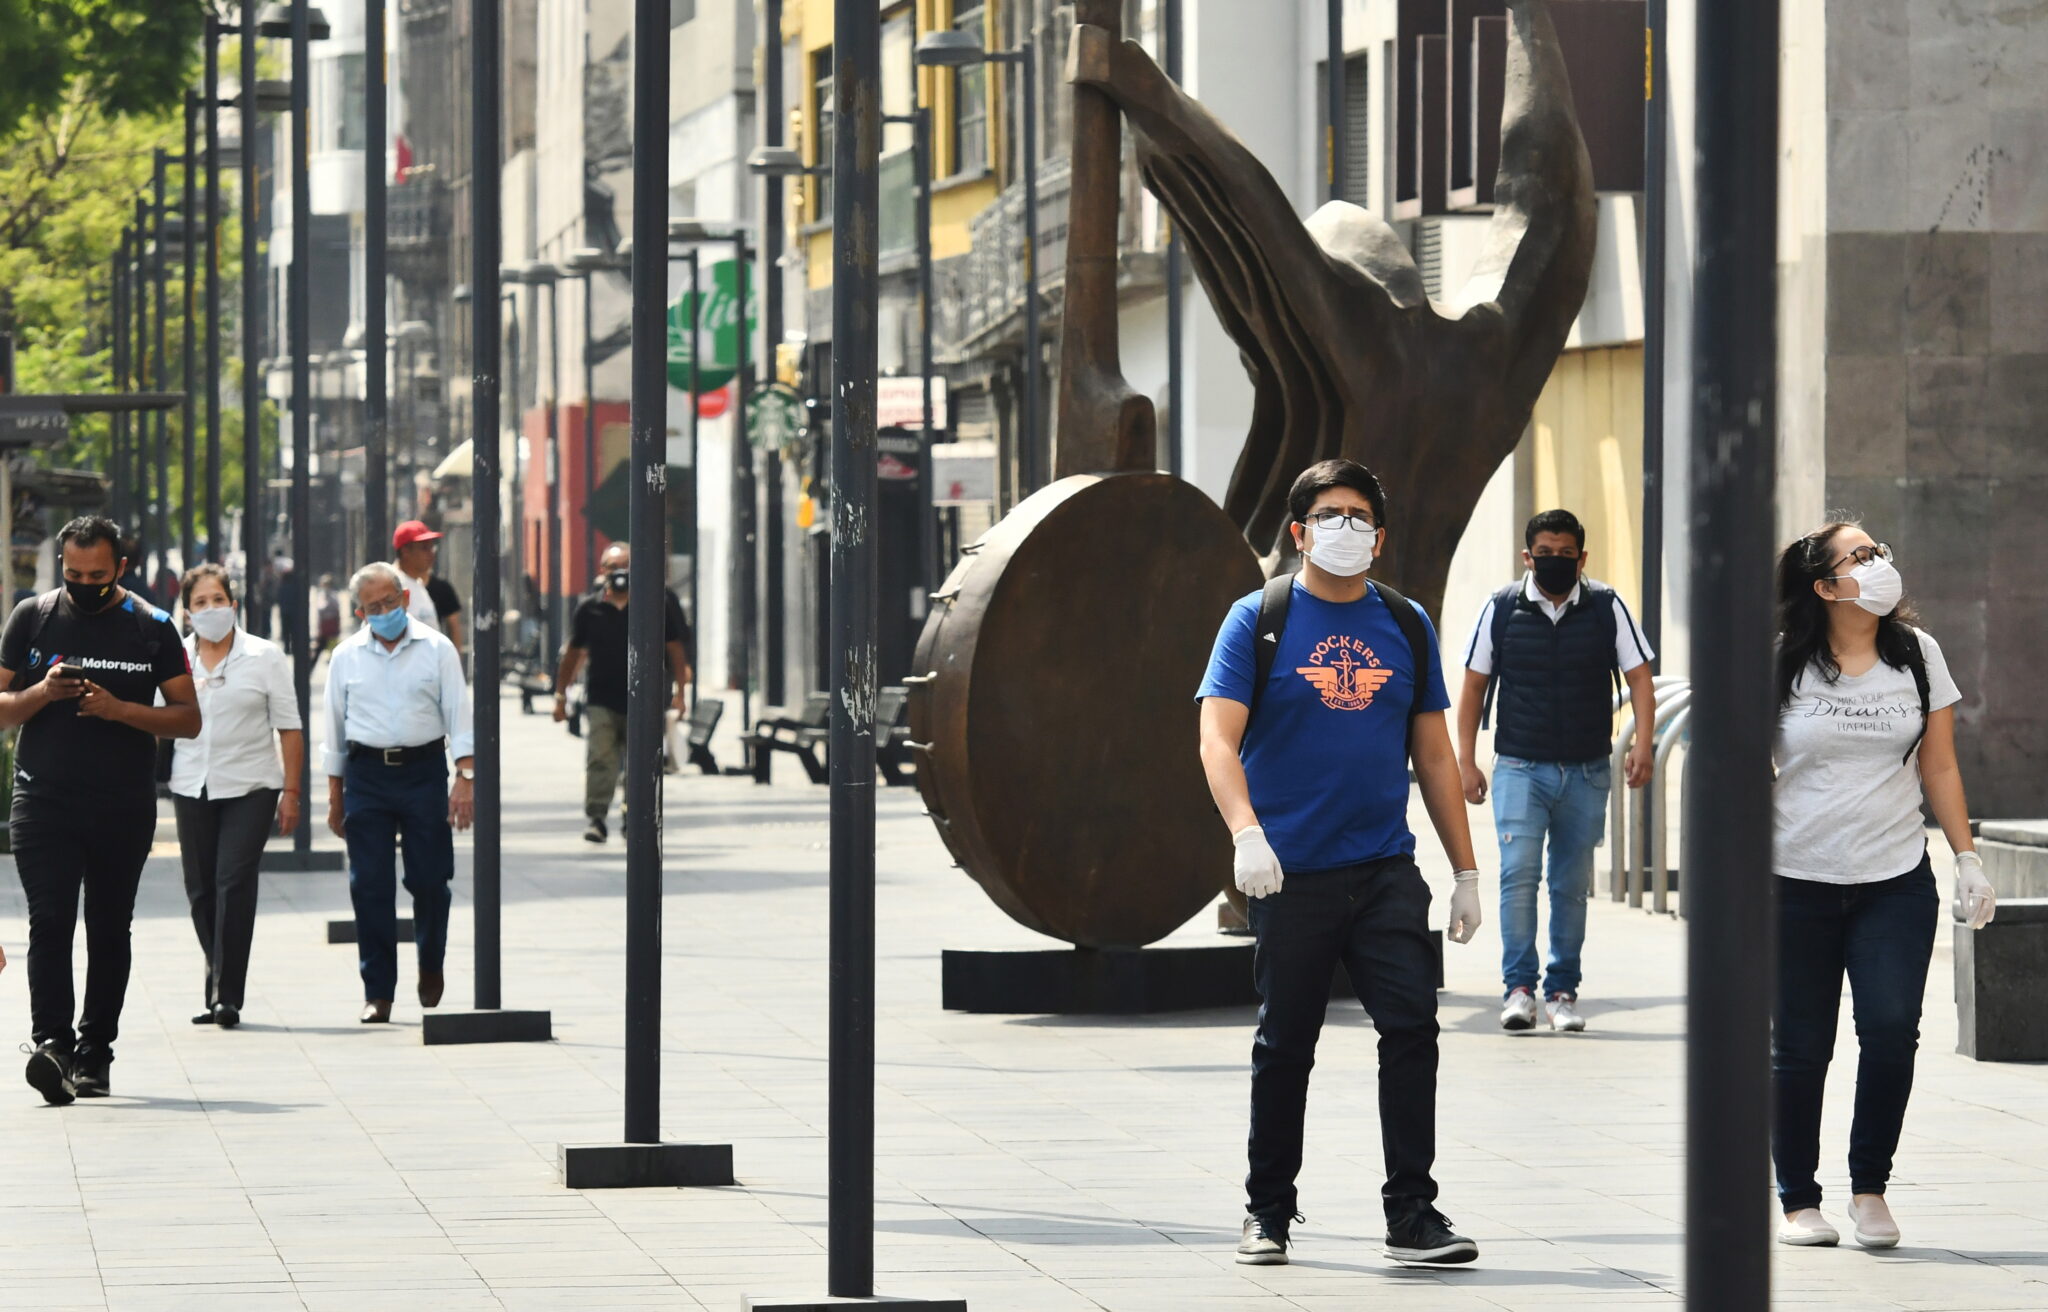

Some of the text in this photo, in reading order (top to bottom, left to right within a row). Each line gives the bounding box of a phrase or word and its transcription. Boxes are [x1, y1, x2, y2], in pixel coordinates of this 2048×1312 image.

[1308, 635, 1381, 668] DOCKERS
[81, 657, 153, 673] Motorsport
[1837, 692, 1885, 705] MAKE YOUR
[1804, 696, 1909, 718] Dreams
[1837, 720, 1892, 732] HAPPEN
